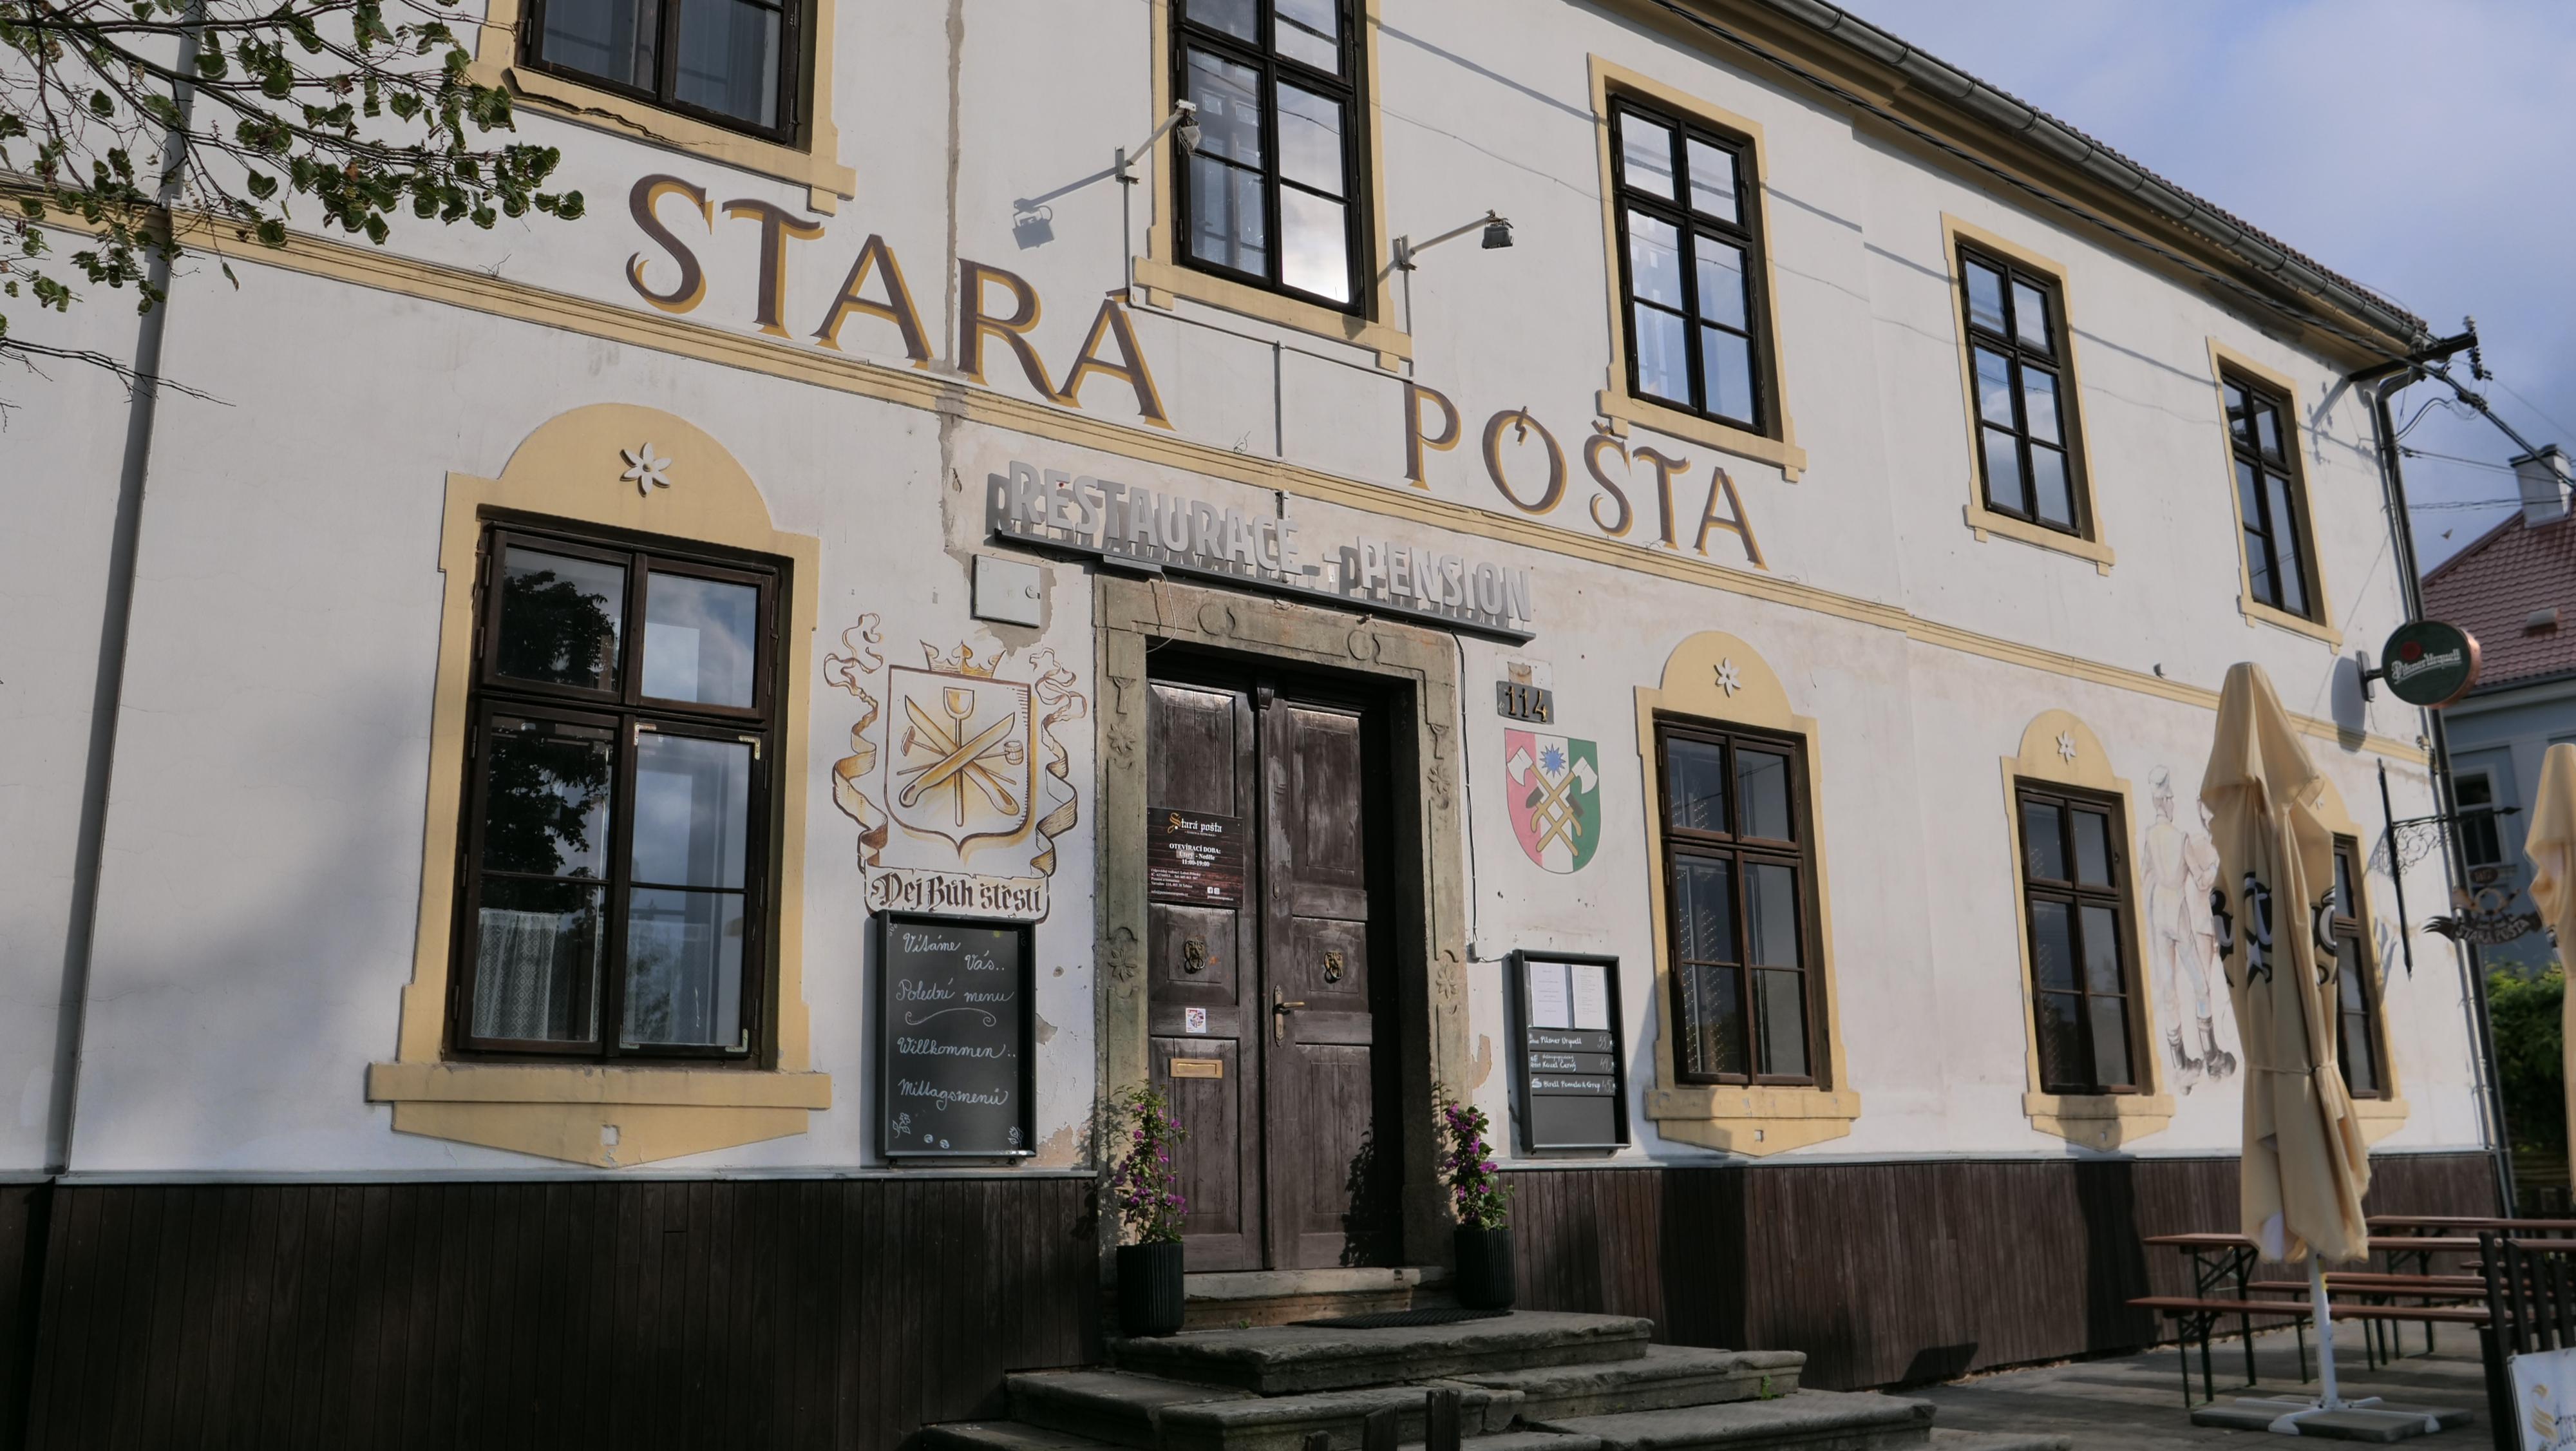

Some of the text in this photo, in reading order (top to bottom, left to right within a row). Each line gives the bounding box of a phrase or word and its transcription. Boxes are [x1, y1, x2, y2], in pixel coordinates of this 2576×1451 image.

[626, 173, 1770, 571] STARÁ POŠTA
[1009, 460, 1303, 575] RESTAURACE
[1357, 536, 1531, 622] PENSION
[2391, 648, 2462, 681] Pilsner Urquell
[1505, 686, 1547, 722] 114
[1167, 813, 1198, 834] Stará
[1201, 822, 1222, 833] pošta
[1170, 843, 1221, 855] OTEVÍRACÍ DOBA:
[871, 871, 1041, 912] Dej Bůh štěstí
[903, 933, 961, 953] Vítáme
[896, 978, 1014, 1002] Polední menu
[1540, 1036, 1560, 1044] Pilsner
[898, 1079, 1009, 1111] Mittagsmenü
